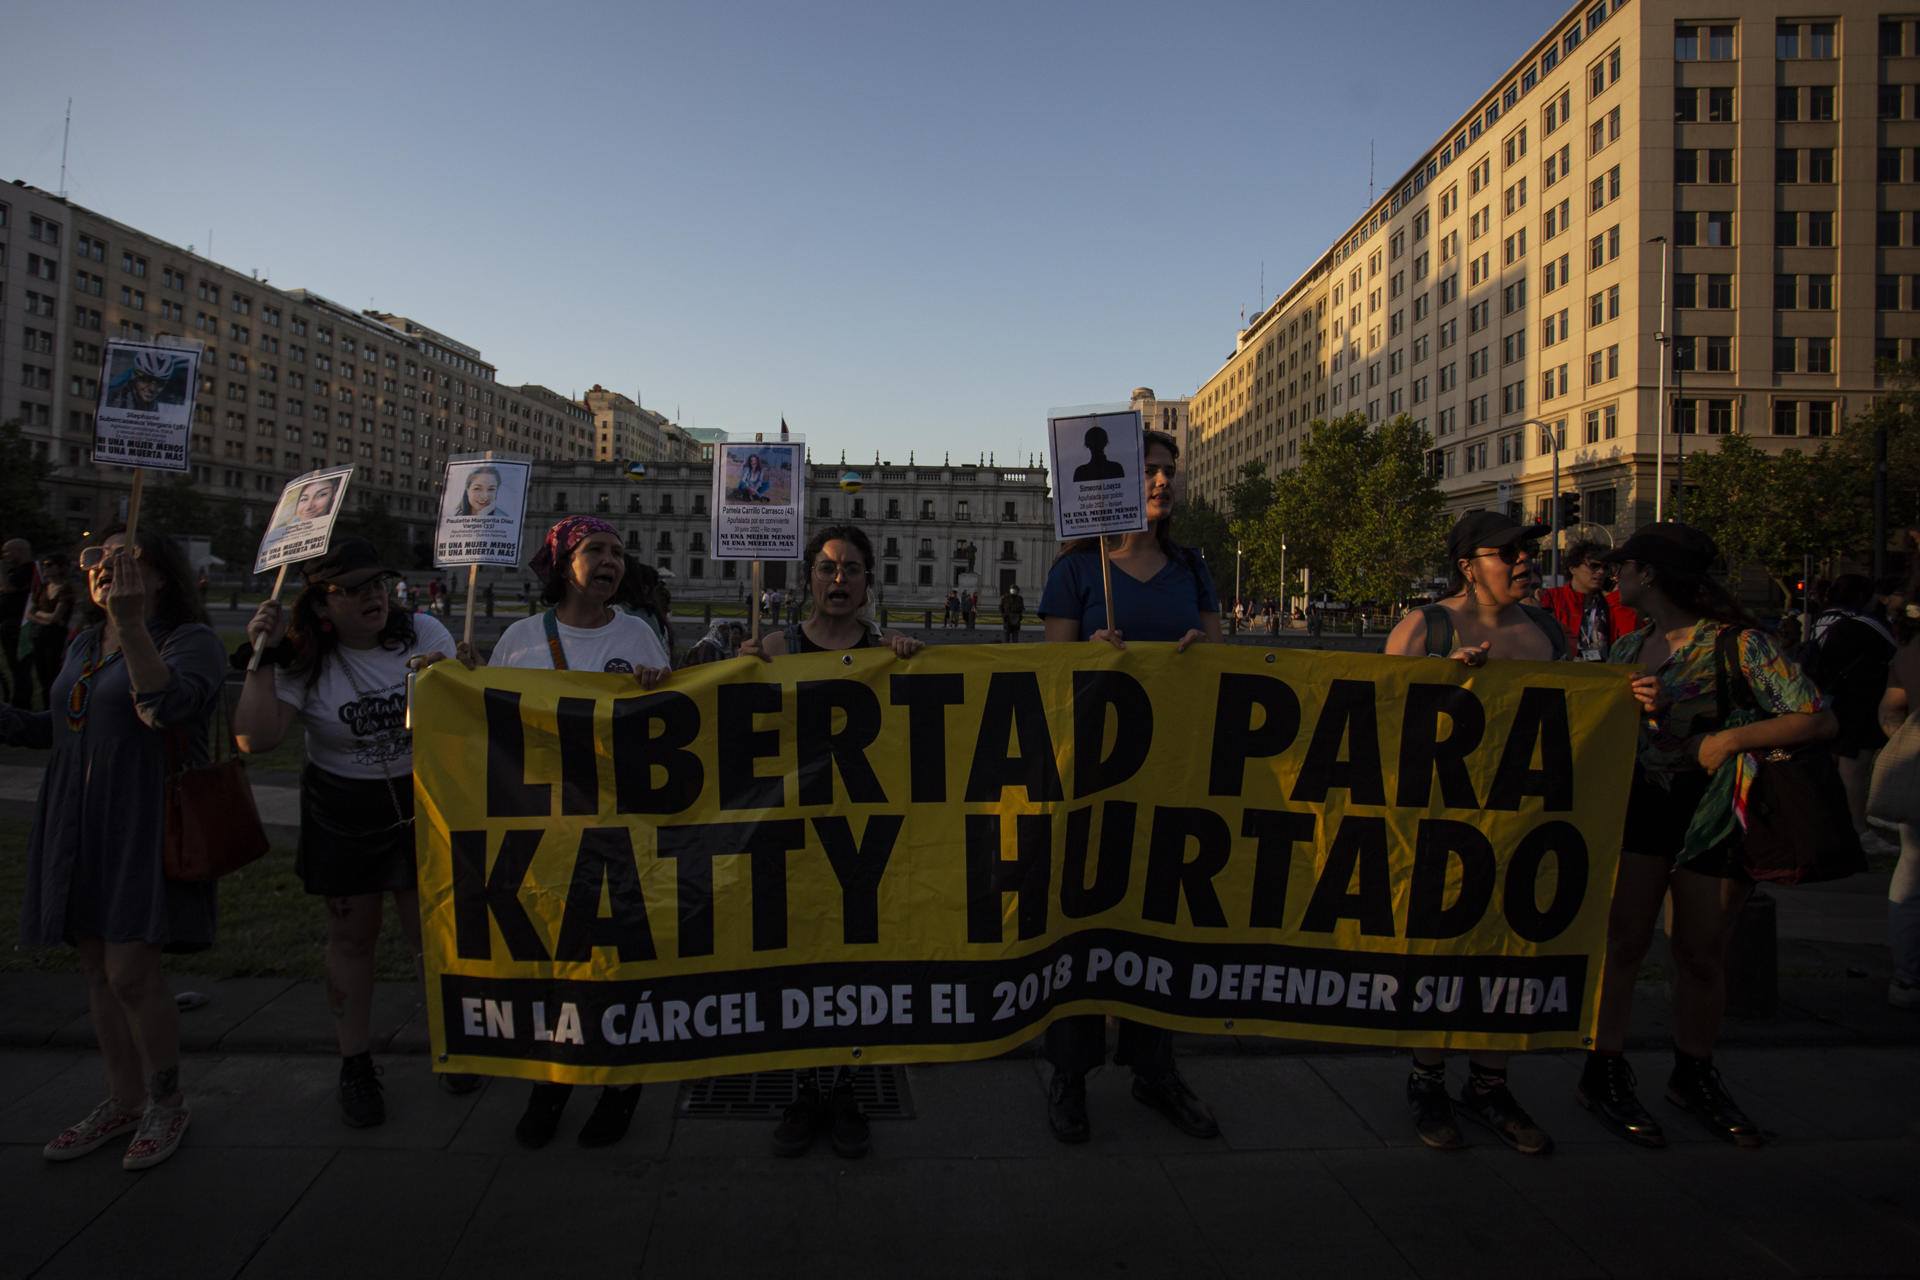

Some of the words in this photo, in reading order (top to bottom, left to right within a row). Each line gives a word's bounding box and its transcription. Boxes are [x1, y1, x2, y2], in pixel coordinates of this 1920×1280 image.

[97, 437, 106, 445] NI
[108, 438, 125, 446] UNA
[127, 440, 153, 450] MUJER
[155, 443, 184, 453] MENOS
[97, 445, 106, 453] NI
[108, 446, 125, 455] UNA
[128, 448, 162, 459] MUERTA
[722, 506, 741, 514] Pamela
[742, 506, 760, 514] Carrillo
[471, 517, 499, 525] Margarita
[269, 547, 281, 555] UNA
[283, 541, 303, 551] MUJER
[304, 535, 326, 545] MENOS
[268, 553, 280, 561] UNA
[282, 546, 308, 556] MUERTA
[485, 671, 1153, 818] LIBERTAD
[1209, 673, 1573, 811] PARA
[450, 815, 904, 962] KATTY
[965, 802, 1589, 942] HURTADO
[462, 997, 516, 1040] EN
[532, 1001, 585, 1046] LA
[601, 990, 765, 1046] CÁRCEL
[781, 985, 913, 1031] DESDE
[930, 984, 976, 1025] EL
[992, 953, 1073, 1022] 2018
[1086, 948, 1174, 997] POR
[1189, 963, 1399, 1012] DEFENDER
[1412, 975, 1463, 1014] SU
[1479, 975, 1569, 1014] VIDA
